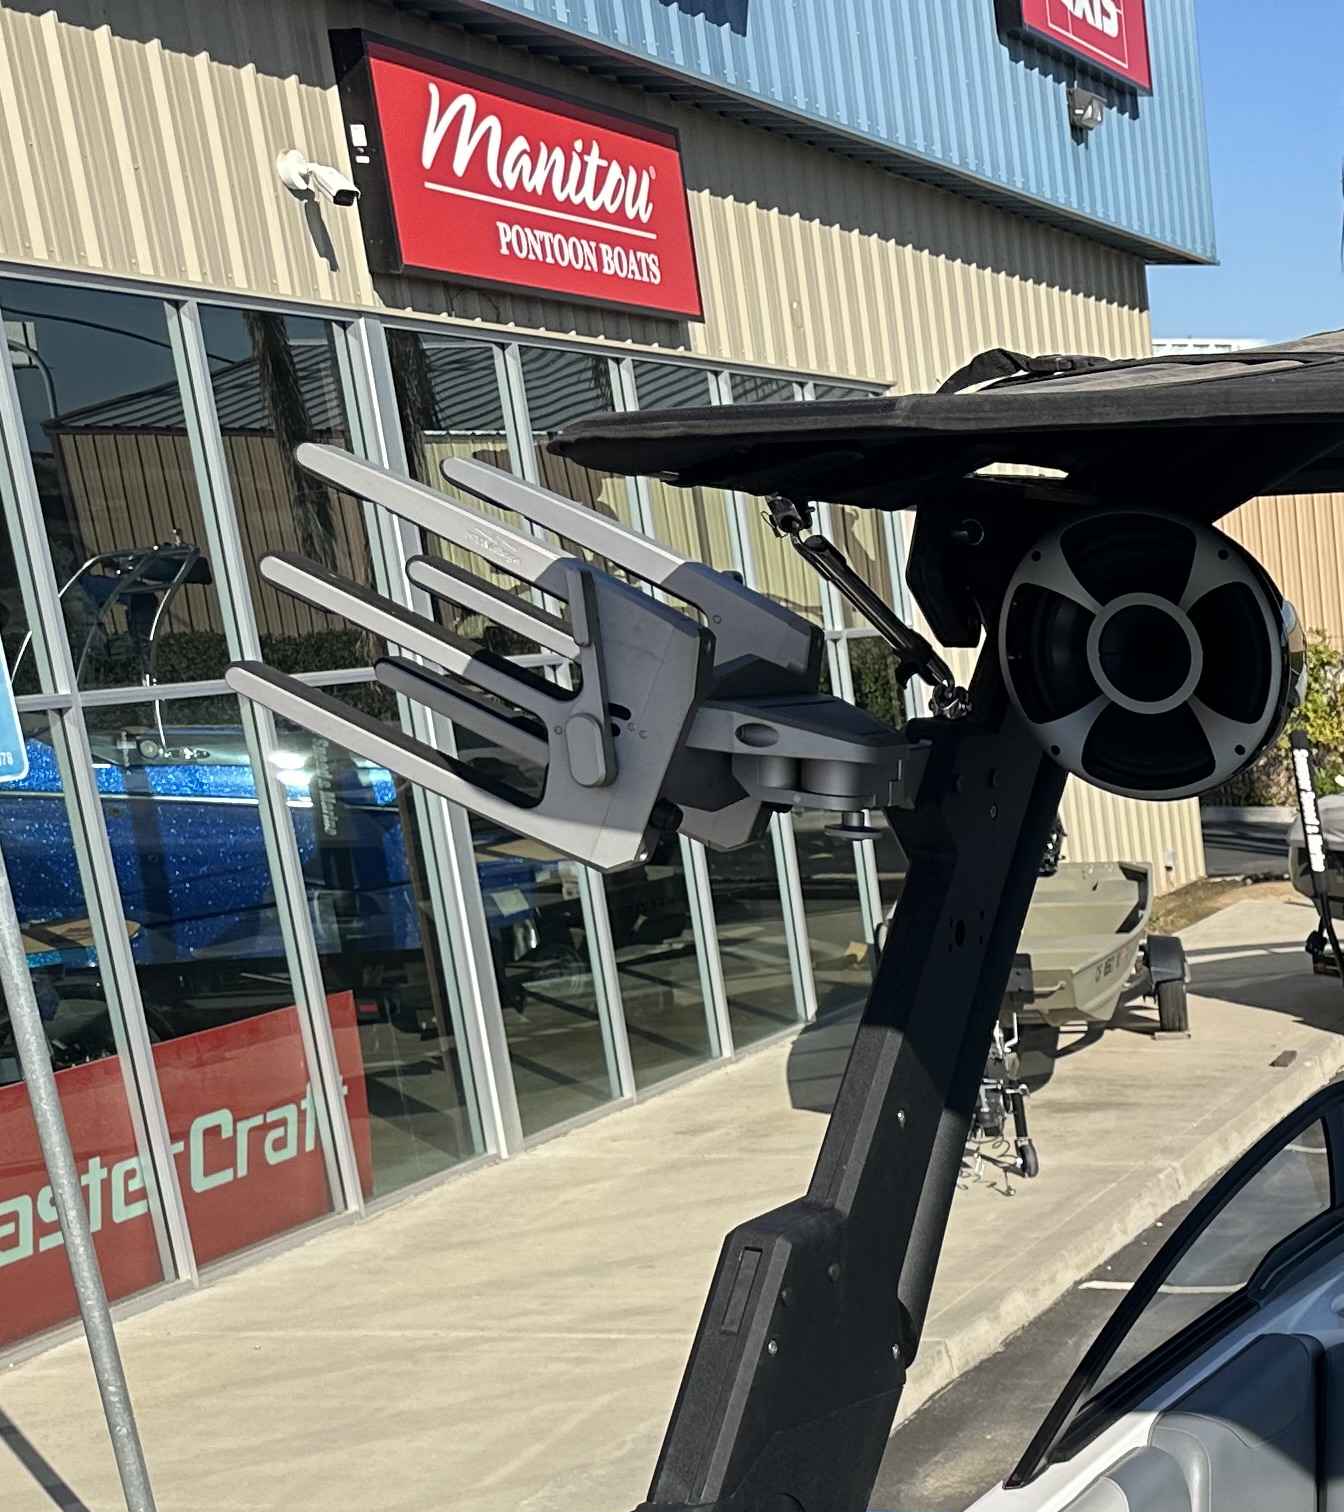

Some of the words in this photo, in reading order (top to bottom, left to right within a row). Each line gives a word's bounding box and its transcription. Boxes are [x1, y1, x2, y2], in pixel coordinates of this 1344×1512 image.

[1060, 0, 1118, 38] XIS
[422, 82, 654, 223] Manitou
[496, 221, 599, 272] PONTOON
[599, 243, 661, 285] BOATS
[0, 1075, 347, 1267] asteCraf
